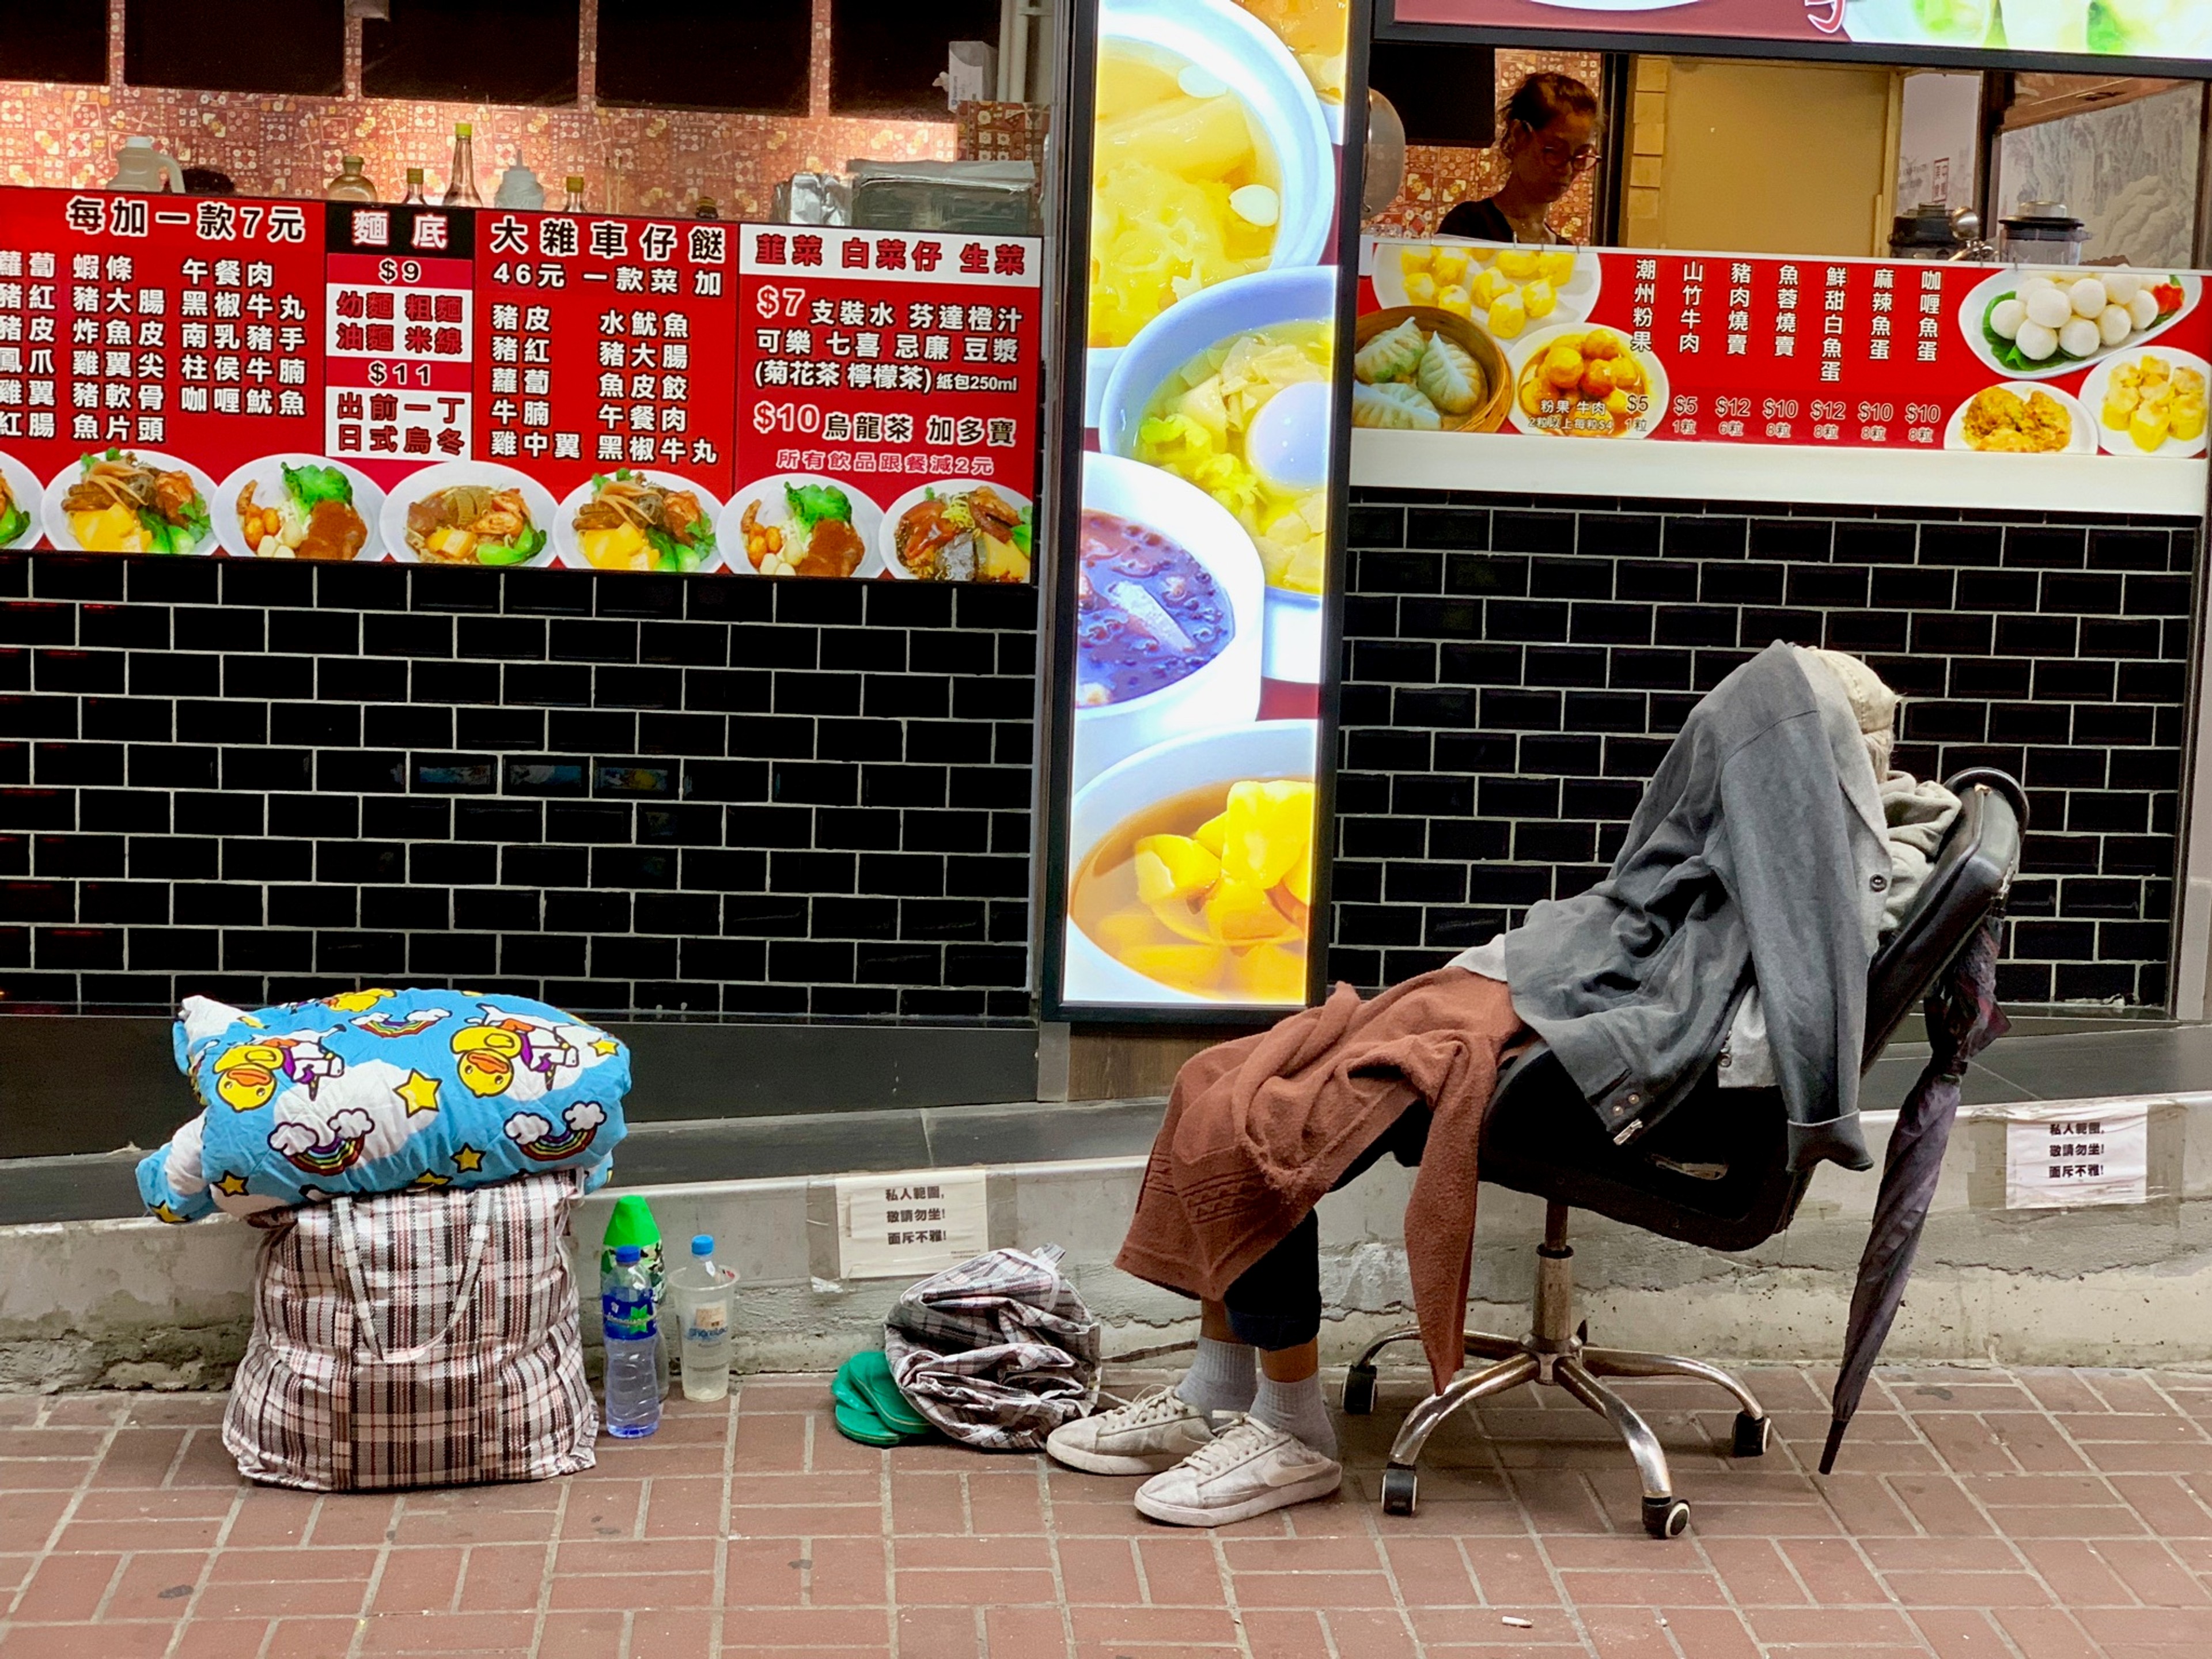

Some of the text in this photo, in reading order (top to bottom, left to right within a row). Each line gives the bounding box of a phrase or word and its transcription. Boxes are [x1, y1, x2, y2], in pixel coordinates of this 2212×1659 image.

[67, 196, 305, 243] 每加一款7元
[491, 215, 725, 264] 大雜車仔餸
[73, 253, 132, 281] 蝦條
[379, 259, 421, 282] $9
[842, 238, 942, 271] 白菜仔
[959, 243, 1025, 275] 生菜
[182, 259, 273, 287] 午餐肉
[494, 263, 721, 296] 46元 一款菜 加
[73, 286, 165, 314] 豬大腸
[181, 291, 305, 320] 黑椒牛丸
[336, 291, 463, 323] 幼麵 粗麵
[757, 285, 1022, 332] $7 支裝水 芬達橙汁
[1630, 259, 1657, 352] 潮州粉果
[1679, 261, 1703, 353] 山竹牛肉
[1727, 263, 1752, 355] 豬肉燒賣
[1774, 265, 1799, 357] 魚蓉燒賣
[492, 305, 550, 332] 豬皮
[600, 310, 688, 338] 水魷魚
[1820, 267, 1847, 382] 鮮甜白魚蛋
[1869, 268, 1894, 361] 麻辣魚蛋
[1916, 270, 1941, 362] 咖喱魚蛋
[73, 318, 164, 346] 炸魚皮
[181, 323, 305, 352] 南乳豬手
[336, 323, 463, 355] 油麵 米線
[757, 329, 1017, 363] 可樂 七喜 忌廉 豆漿
[492, 336, 550, 363] 豬紅
[599, 342, 688, 369] 豬大腸
[73, 350, 164, 378] 雞翼尖
[181, 355, 305, 384] 柱侯牛腩
[369, 362, 430, 386] $11
[755, 360, 1017, 393] (菊花茶 檸檬茶) 紙包250ml
[491, 368, 550, 395] 蘿蔔
[599, 373, 687, 400] 魚皮餃
[73, 382, 164, 410] 豬軟骨
[181, 387, 305, 416] 咖喱魷魚
[338, 392, 465, 424] 出前一丁
[1541, 400, 1605, 415] 粉果 牛肉
[1626, 394, 1649, 414] $5
[1673, 396, 1698, 415] $5
[1715, 396, 1751, 418] $12
[1763, 398, 1798, 419] $10
[1810, 399, 1845, 421] $12
[491, 400, 549, 426] 牛腩
[599, 404, 685, 431] 午餐肉
[753, 401, 1016, 447] $10 烏龍茶 加多寶
[1624, 418, 1647, 432] 1粒
[1858, 401, 1893, 422] $10
[1905, 403, 1941, 425] $10
[73, 414, 164, 442] 魚片頭
[338, 424, 465, 456] 日式烏冬
[1673, 419, 1696, 435] 1粒
[1718, 421, 1743, 437] 6粒
[1766, 422, 1790, 438] 8粒
[1813, 423, 1839, 440] 8粒
[1861, 425, 1885, 441] 8粒
[1908, 426, 1933, 443] 8粒
[491, 431, 580, 459] 雞中翼
[598, 435, 717, 463] 黑椒牛丸
[776, 449, 995, 476] 所有飲品跟餐減2元
